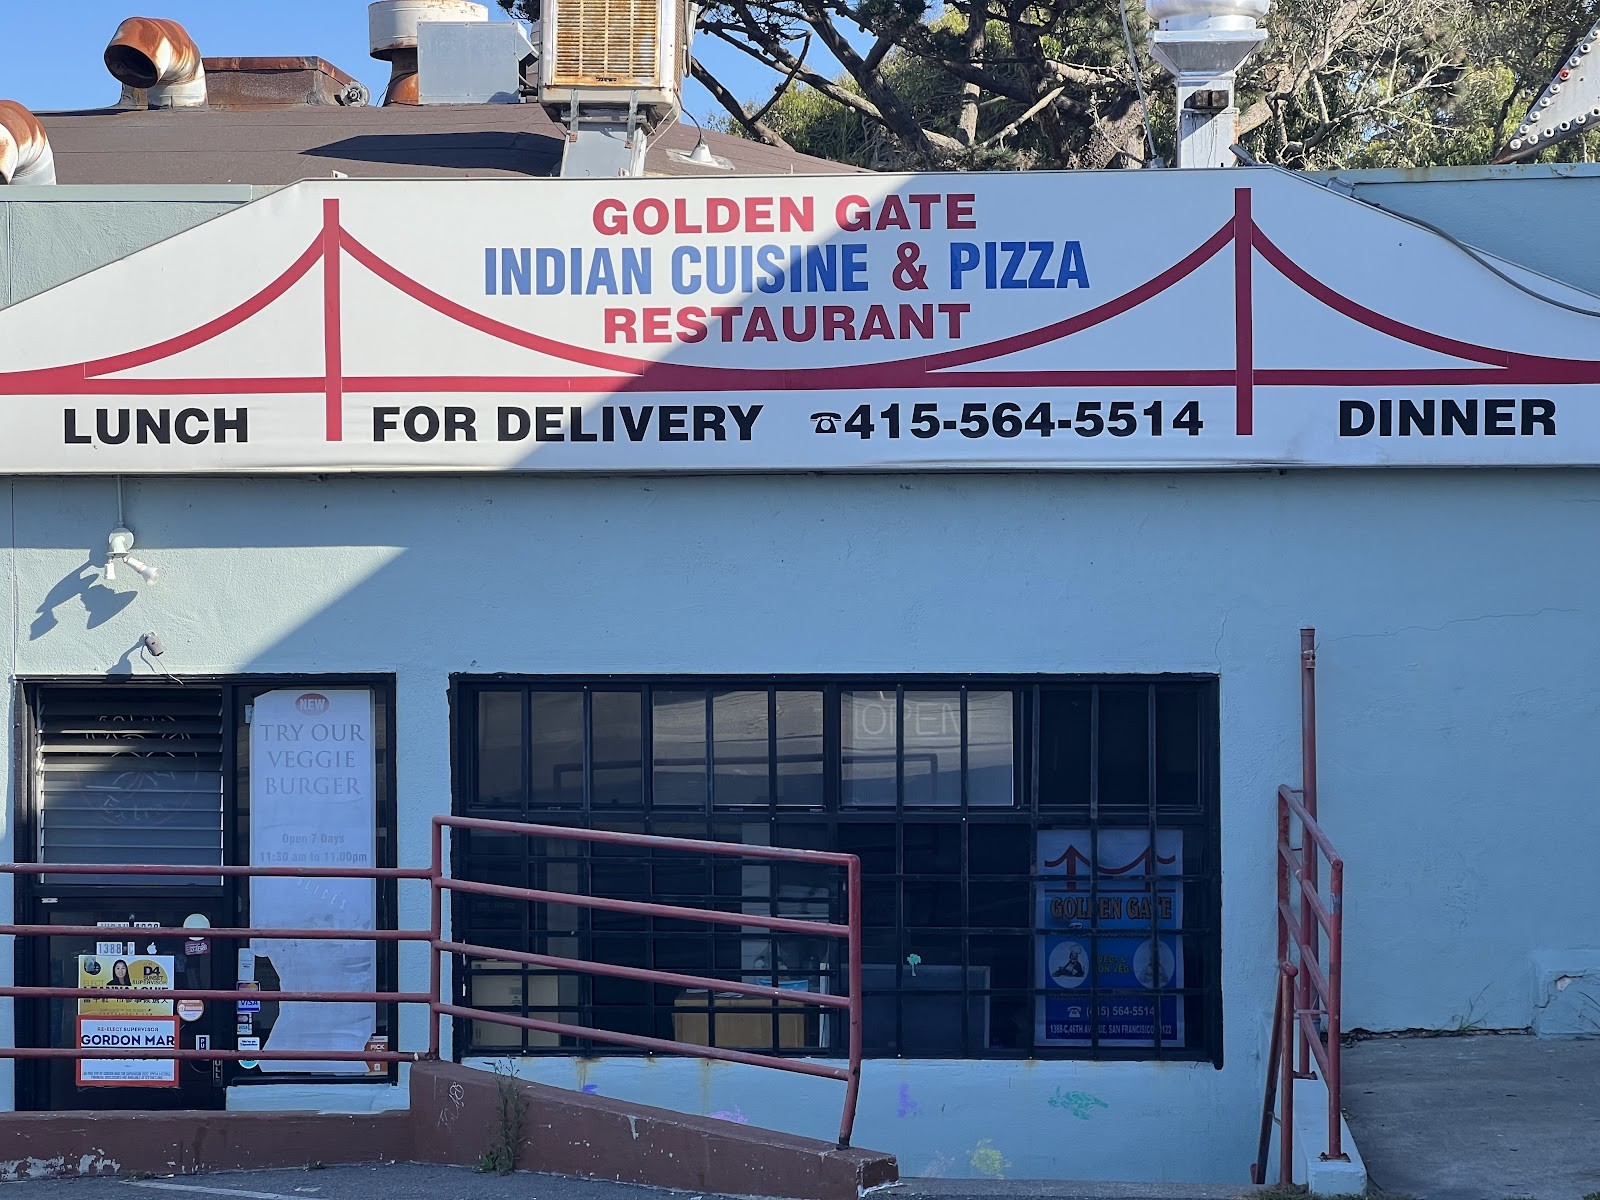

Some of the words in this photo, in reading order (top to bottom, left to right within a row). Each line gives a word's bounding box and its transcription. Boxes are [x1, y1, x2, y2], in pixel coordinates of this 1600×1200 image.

[593, 197, 814, 235] GOLDEN
[837, 194, 977, 230] GATE
[485, 247, 652, 296] INDIAN
[671, 243, 868, 294] CUISINE
[892, 241, 928, 290] &
[950, 240, 1091, 290] PIZZA
[604, 303, 971, 344] RESTAURANT
[64, 407, 249, 445] LUNCH
[373, 406, 477, 443] FOR
[497, 404, 764, 442] DELIVERY
[843, 401, 1204, 439] 415-564-5514
[1339, 397, 1557, 437] DINNER
[299, 698, 327, 711] NEW
[861, 703, 961, 736] OPEN
[259, 723, 304, 741] TRY
[311, 723, 366, 742] OUR
[267, 750, 356, 769] VEGGIE
[265, 777, 362, 795] BURGER
[282, 833, 308, 846] Open
[311, 833, 317, 844] 7
[320, 833, 345, 847] Days
[260, 851, 289, 862] 11:30
[291, 853, 307, 862] am
[309, 851, 320, 862] to
[1050, 896, 1122, 920] GOLEN
[1126, 896, 1172, 920] GAE
[98, 943, 122, 954] 1388
[143, 966, 161, 976] D4
[81, 1034, 140, 1046] GORDON
[145, 1035, 175, 1046] MAR
